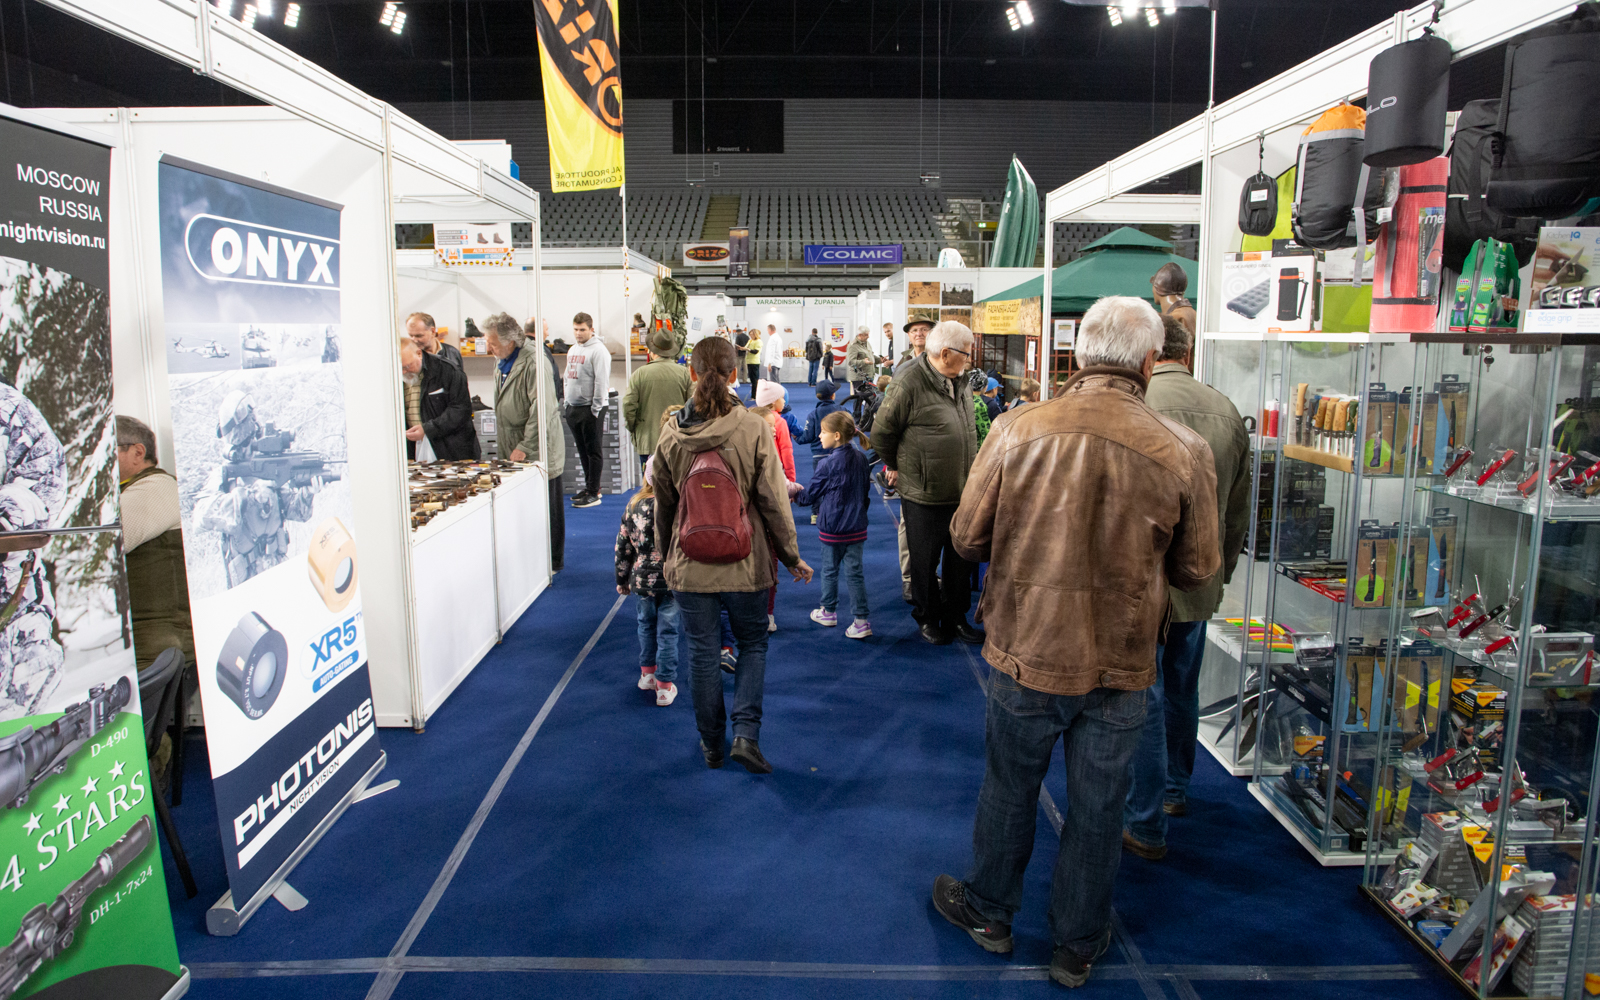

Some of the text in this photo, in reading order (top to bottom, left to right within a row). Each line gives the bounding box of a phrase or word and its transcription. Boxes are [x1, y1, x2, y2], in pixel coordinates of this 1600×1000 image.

[17, 163, 100, 196] MOSCOW
[39, 196, 103, 222] RUSSIA
[0, 220, 106, 249] nightvision.ru
[211, 227, 335, 284] ONYX
[686, 249, 728, 258] ORIZO
[822, 251, 894, 260] COLMIC
[1261, 507, 1288, 520] ATM
[309, 615, 358, 673] XR5
[90, 726, 129, 758] D-490
[233, 697, 373, 846] PHOTONIS
[289, 758, 341, 813] NIGHT VISION
[0, 769, 147, 893] 4 STARS
[90, 865, 153, 925] DH-1-7x24
